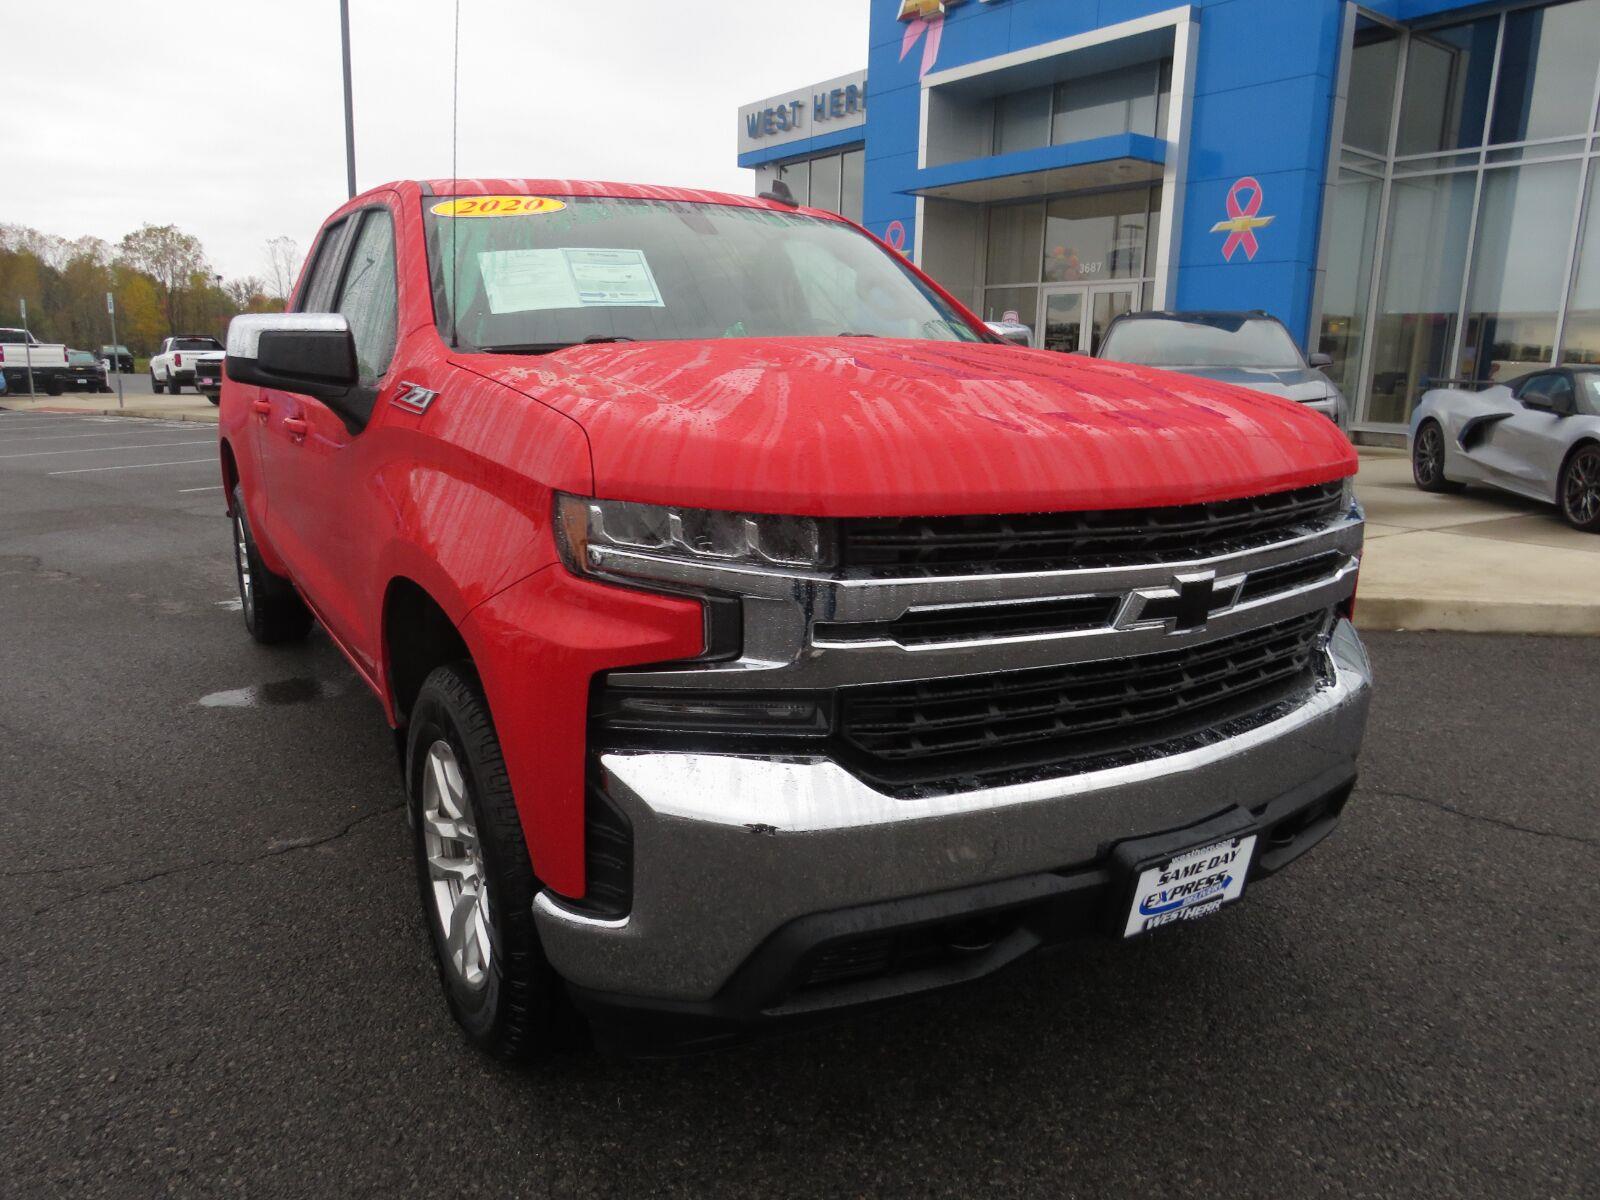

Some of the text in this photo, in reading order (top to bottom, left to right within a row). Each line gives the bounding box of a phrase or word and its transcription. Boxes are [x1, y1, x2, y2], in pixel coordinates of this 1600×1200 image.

[746, 100, 801, 139] WEST
[457, 199, 544, 214] 2020
[1079, 262, 1102, 274] 3687
[390, 381, 439, 415] Z71
[1157, 848, 1241, 887] SAME DAY
[1145, 870, 1228, 908] EXPRESS
